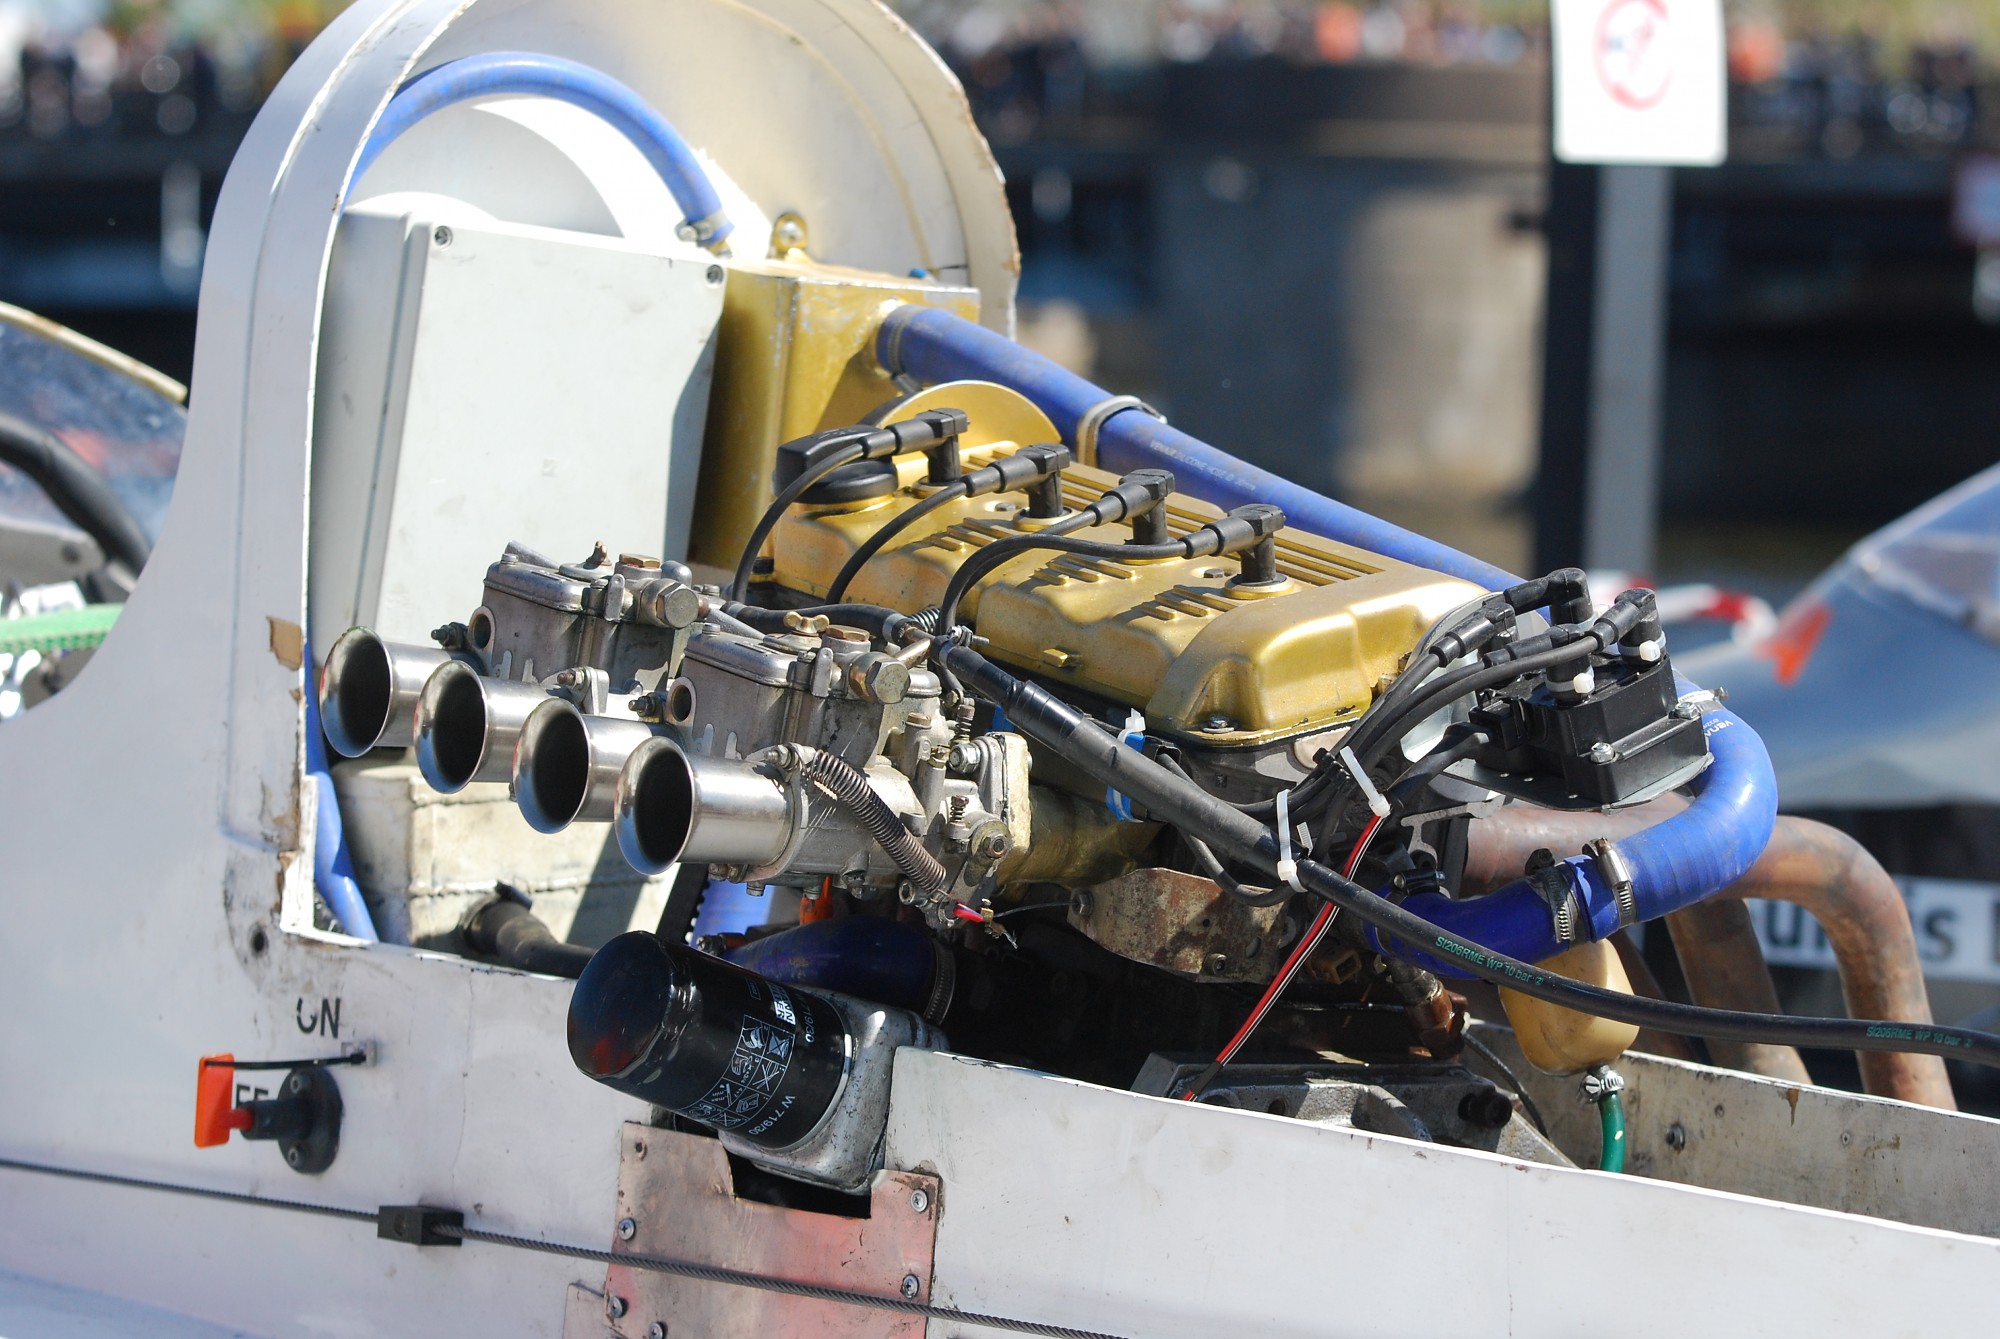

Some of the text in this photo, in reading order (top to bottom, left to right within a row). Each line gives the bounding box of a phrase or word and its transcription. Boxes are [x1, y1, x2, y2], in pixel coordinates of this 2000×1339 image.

[1435, 936, 1486, 965] SI206RME
[1486, 957, 1503, 970] WP
[1504, 965, 1516, 977] 10
[1515, 969, 1532, 982] bar
[296, 997, 341, 1039] ON
[748, 1095, 796, 1135] W 719/30
